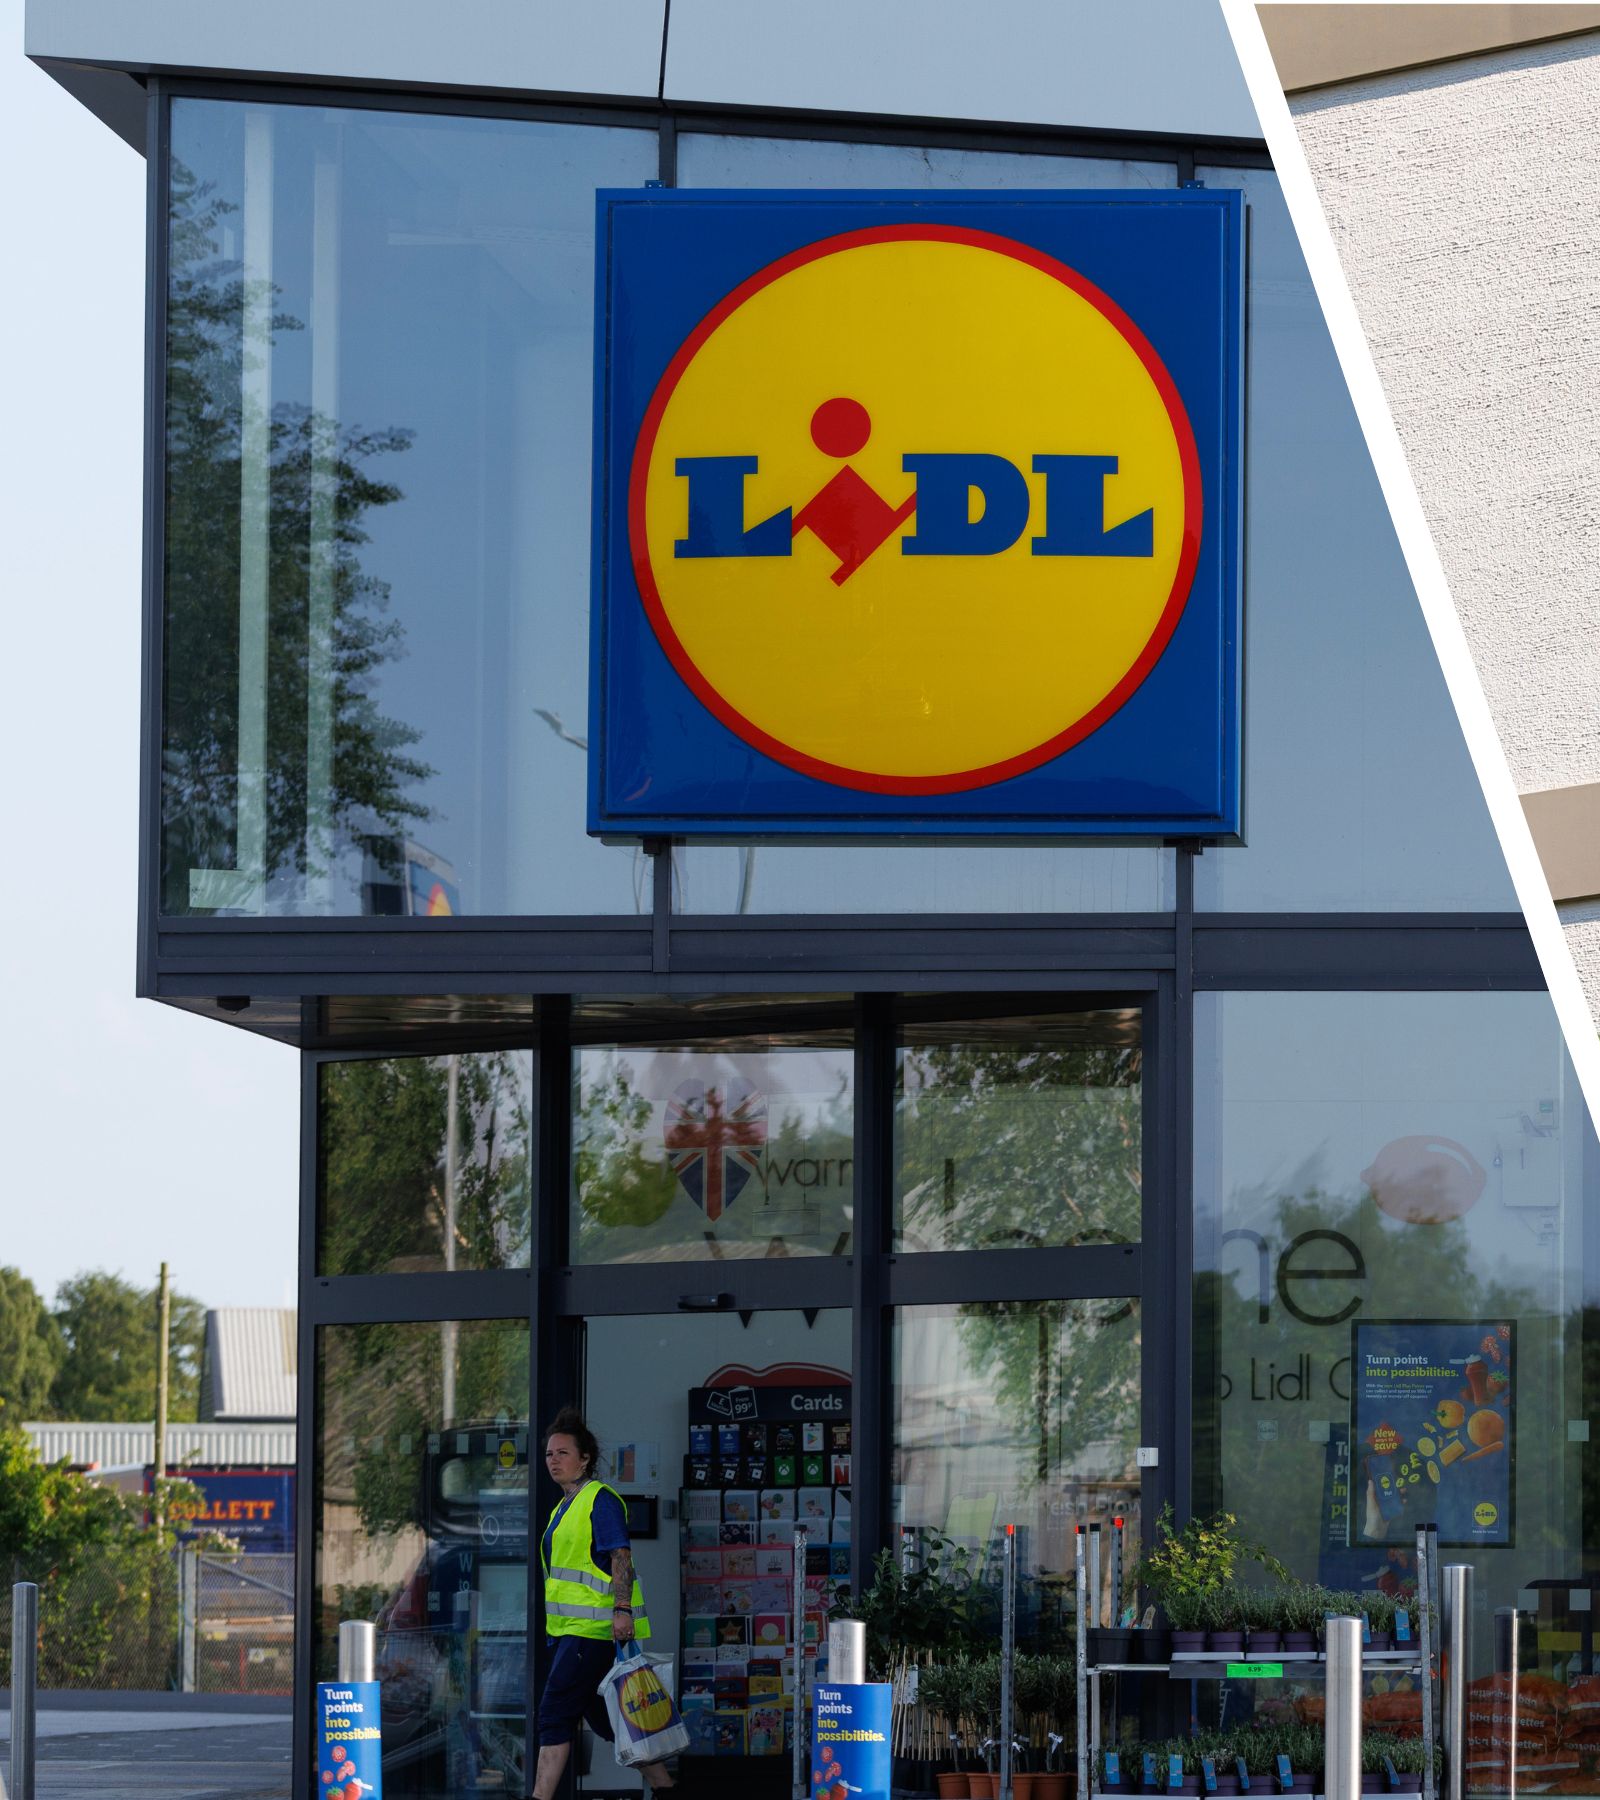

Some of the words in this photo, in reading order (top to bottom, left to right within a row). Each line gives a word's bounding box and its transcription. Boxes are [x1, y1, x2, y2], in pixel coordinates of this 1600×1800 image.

[1365, 1354, 1391, 1365] Turn
[1394, 1354, 1428, 1367] points
[1251, 1353, 1310, 1401] Lidl
[1365, 1366, 1388, 1377] into
[1391, 1366, 1460, 1379] possibilities.
[790, 1393, 843, 1411] Cards
[1374, 1428, 1396, 1439] New
[1374, 1442, 1398, 1451] save
[168, 1500, 276, 1521] COLLETT
[324, 1688, 353, 1701] Turn
[818, 1688, 842, 1701] Turn
[324, 1701, 364, 1716] points
[817, 1702, 853, 1716] points
[325, 1716, 351, 1728] into
[817, 1716, 838, 1729] into
[816, 1729, 886, 1743] possibilities.
